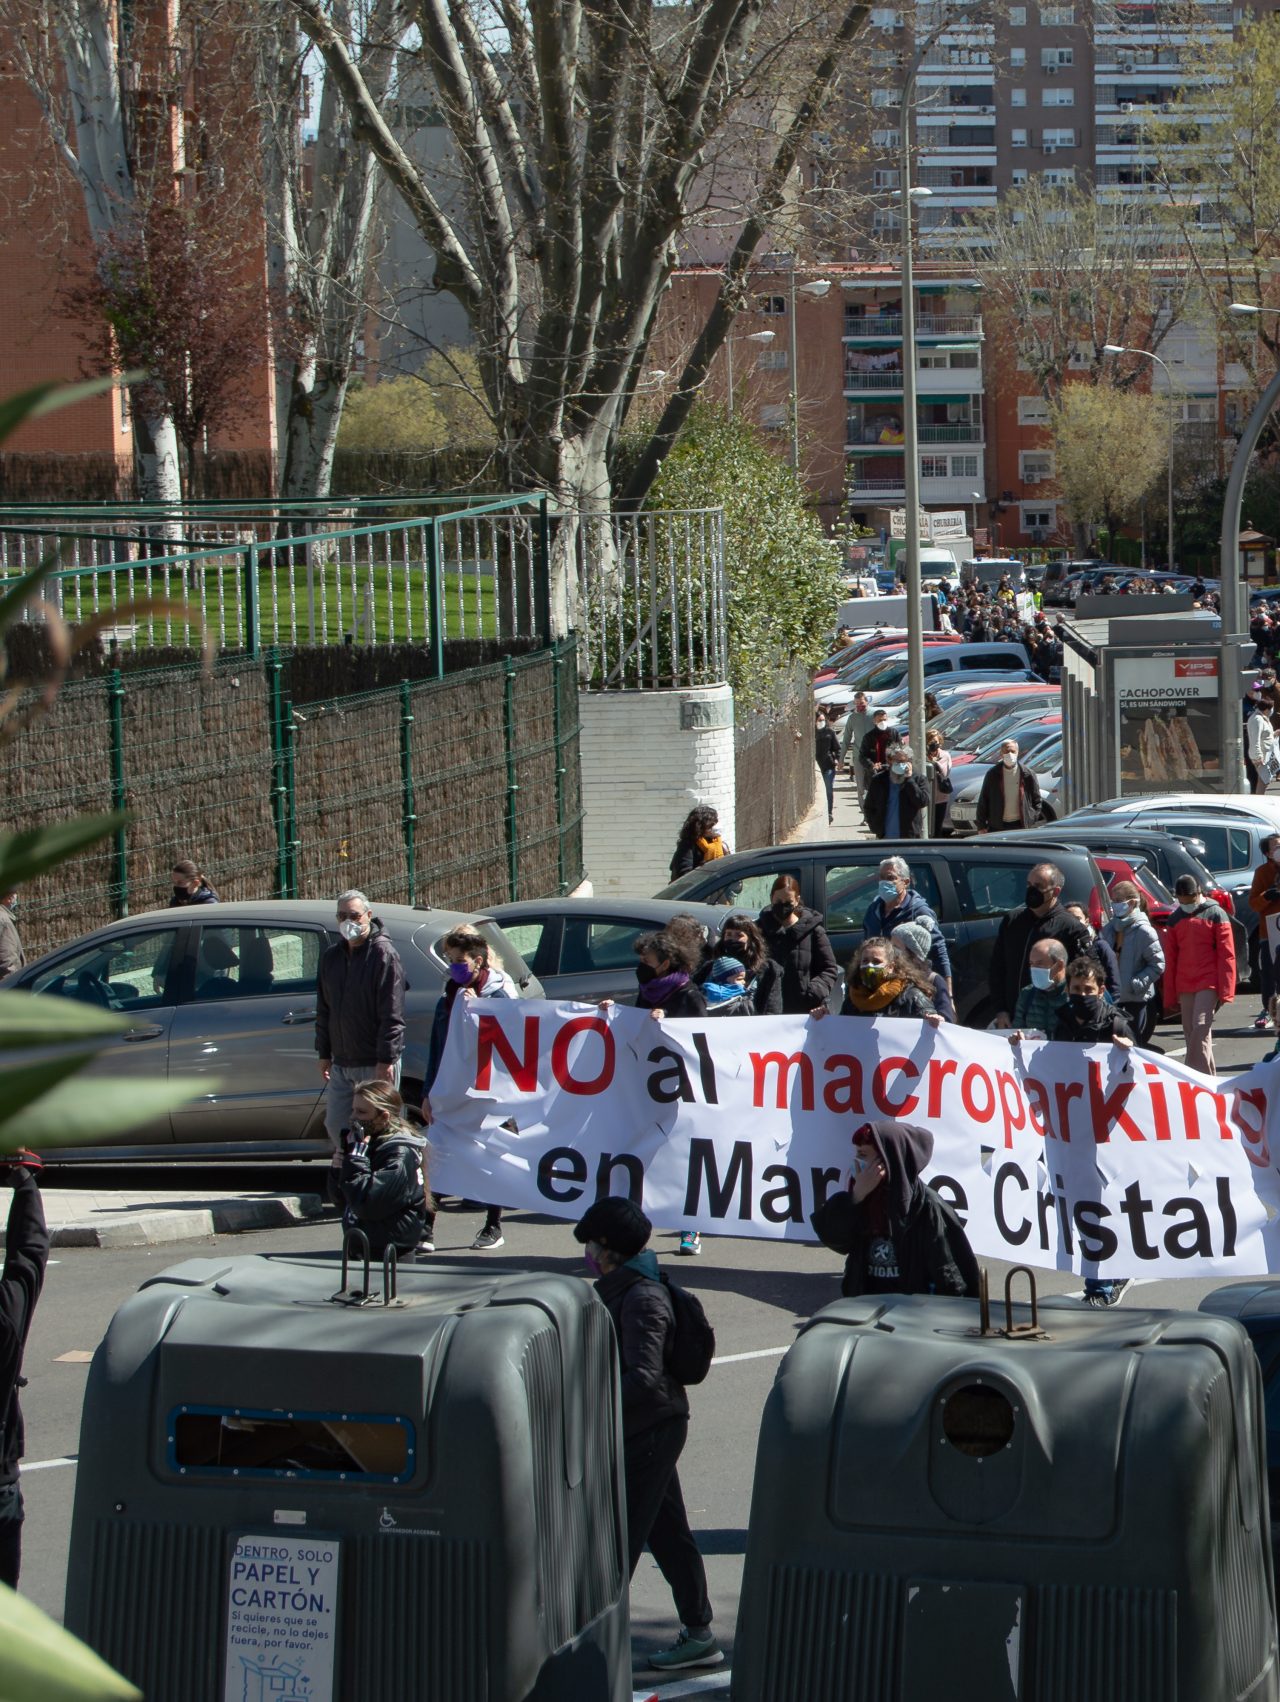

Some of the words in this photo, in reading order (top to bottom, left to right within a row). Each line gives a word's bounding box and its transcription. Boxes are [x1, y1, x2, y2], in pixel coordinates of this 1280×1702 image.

[1119, 687, 1200, 698] CACHOPOWER
[1138, 700, 1149, 708] UN
[476, 1015, 616, 1096] NO
[647, 1032, 718, 1105] al
[749, 1050, 1269, 1168] macroparking
[537, 1146, 645, 1202] en
[683, 1137, 842, 1224] Mar
[991, 1160, 1237, 1262] Cristal
[235, 1545, 292, 1562] DENTRO,
[297, 1550, 333, 1563] SOLO
[233, 1562, 300, 1585] PAPEL
[307, 1567, 320, 1586] Y
[231, 1587, 331, 1613] CARTÓN.
[243, 1613, 281, 1626] quieres
[284, 1617, 303, 1626] que
[306, 1618, 318, 1626] se
[231, 1624, 270, 1636] recicle,
[273, 1627, 287, 1636] no
[289, 1627, 300, 1637] lo
[302, 1628, 329, 1641] dejes
[230, 1635, 260, 1648] fuera,
[264, 1639, 282, 1650] por
[284, 1638, 314, 1650] favor.
